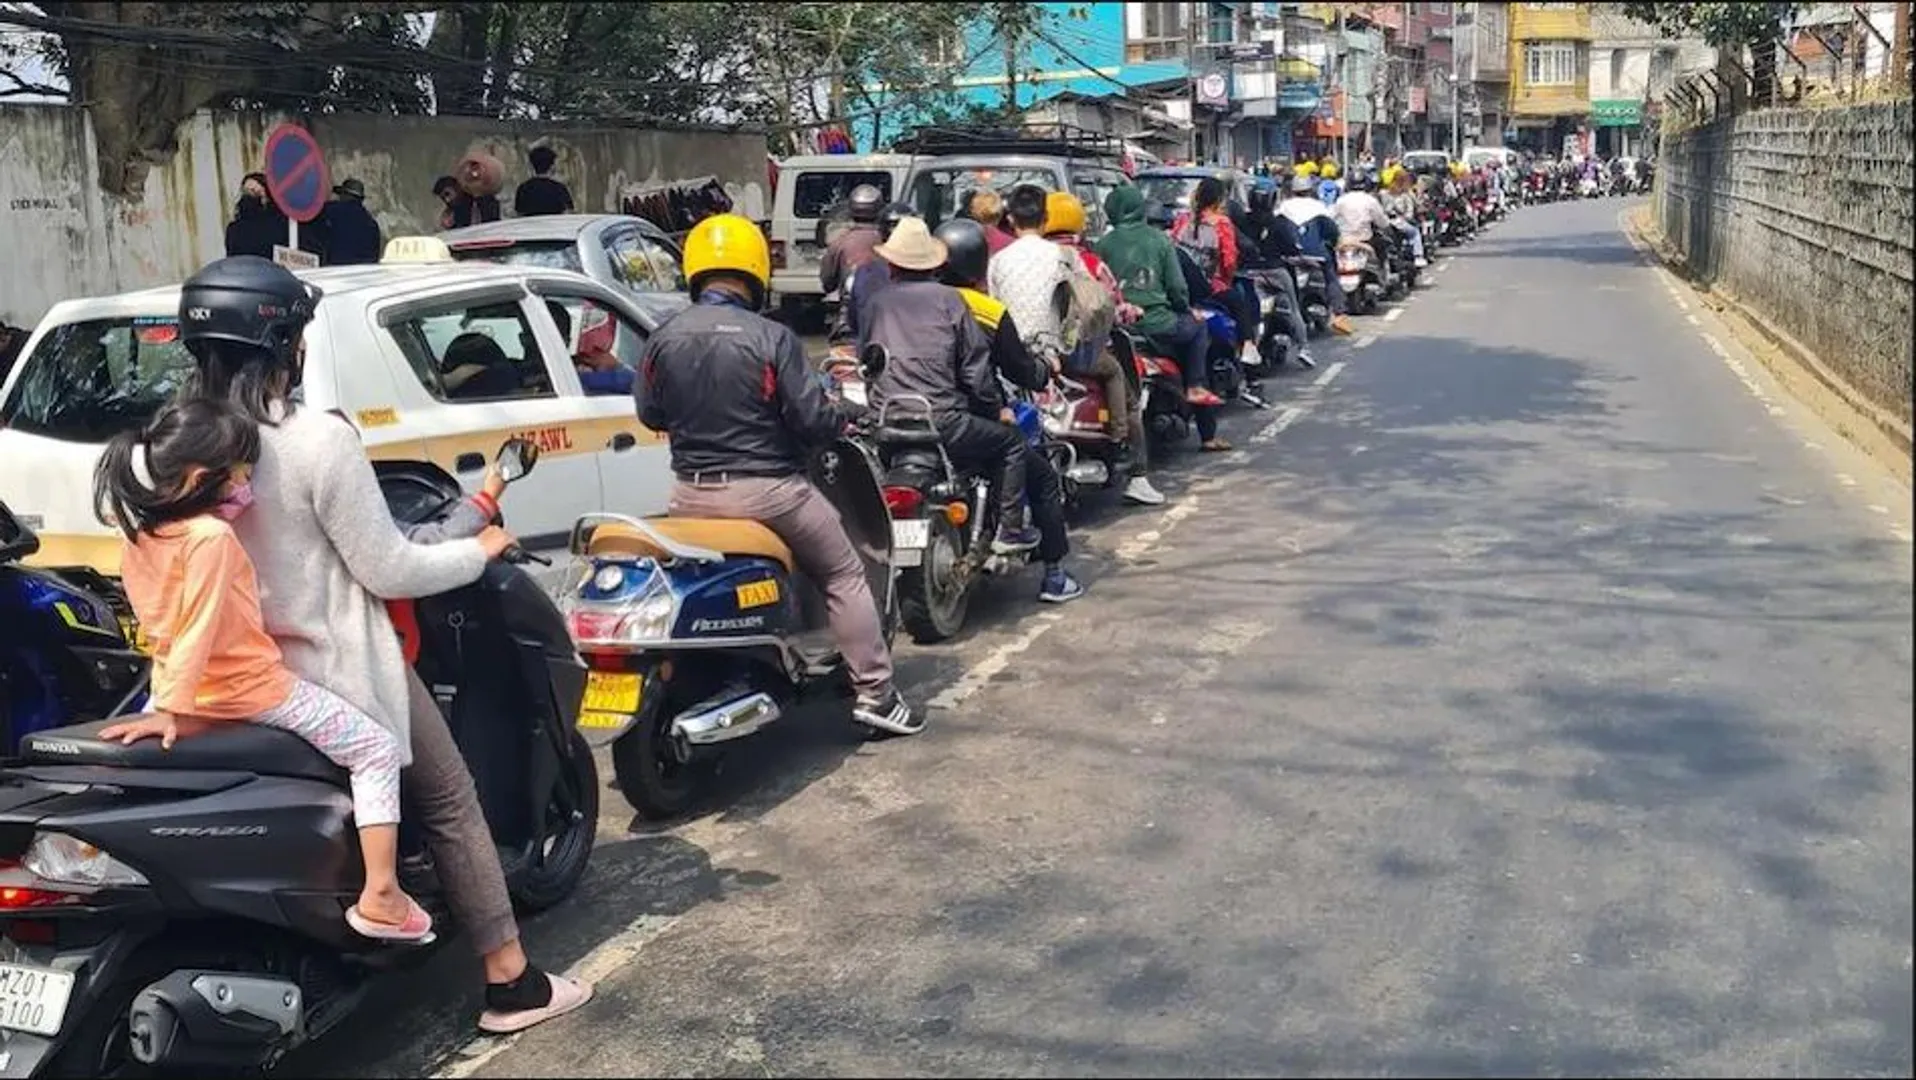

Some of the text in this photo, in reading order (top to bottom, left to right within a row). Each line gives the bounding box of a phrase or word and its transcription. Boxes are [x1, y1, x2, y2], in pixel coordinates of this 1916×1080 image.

[394, 240, 427, 256] TAXI
[509, 426, 573, 454] ZAWL
[742, 582, 777, 605] TAXI
[32, 741, 81, 754] HONDA
